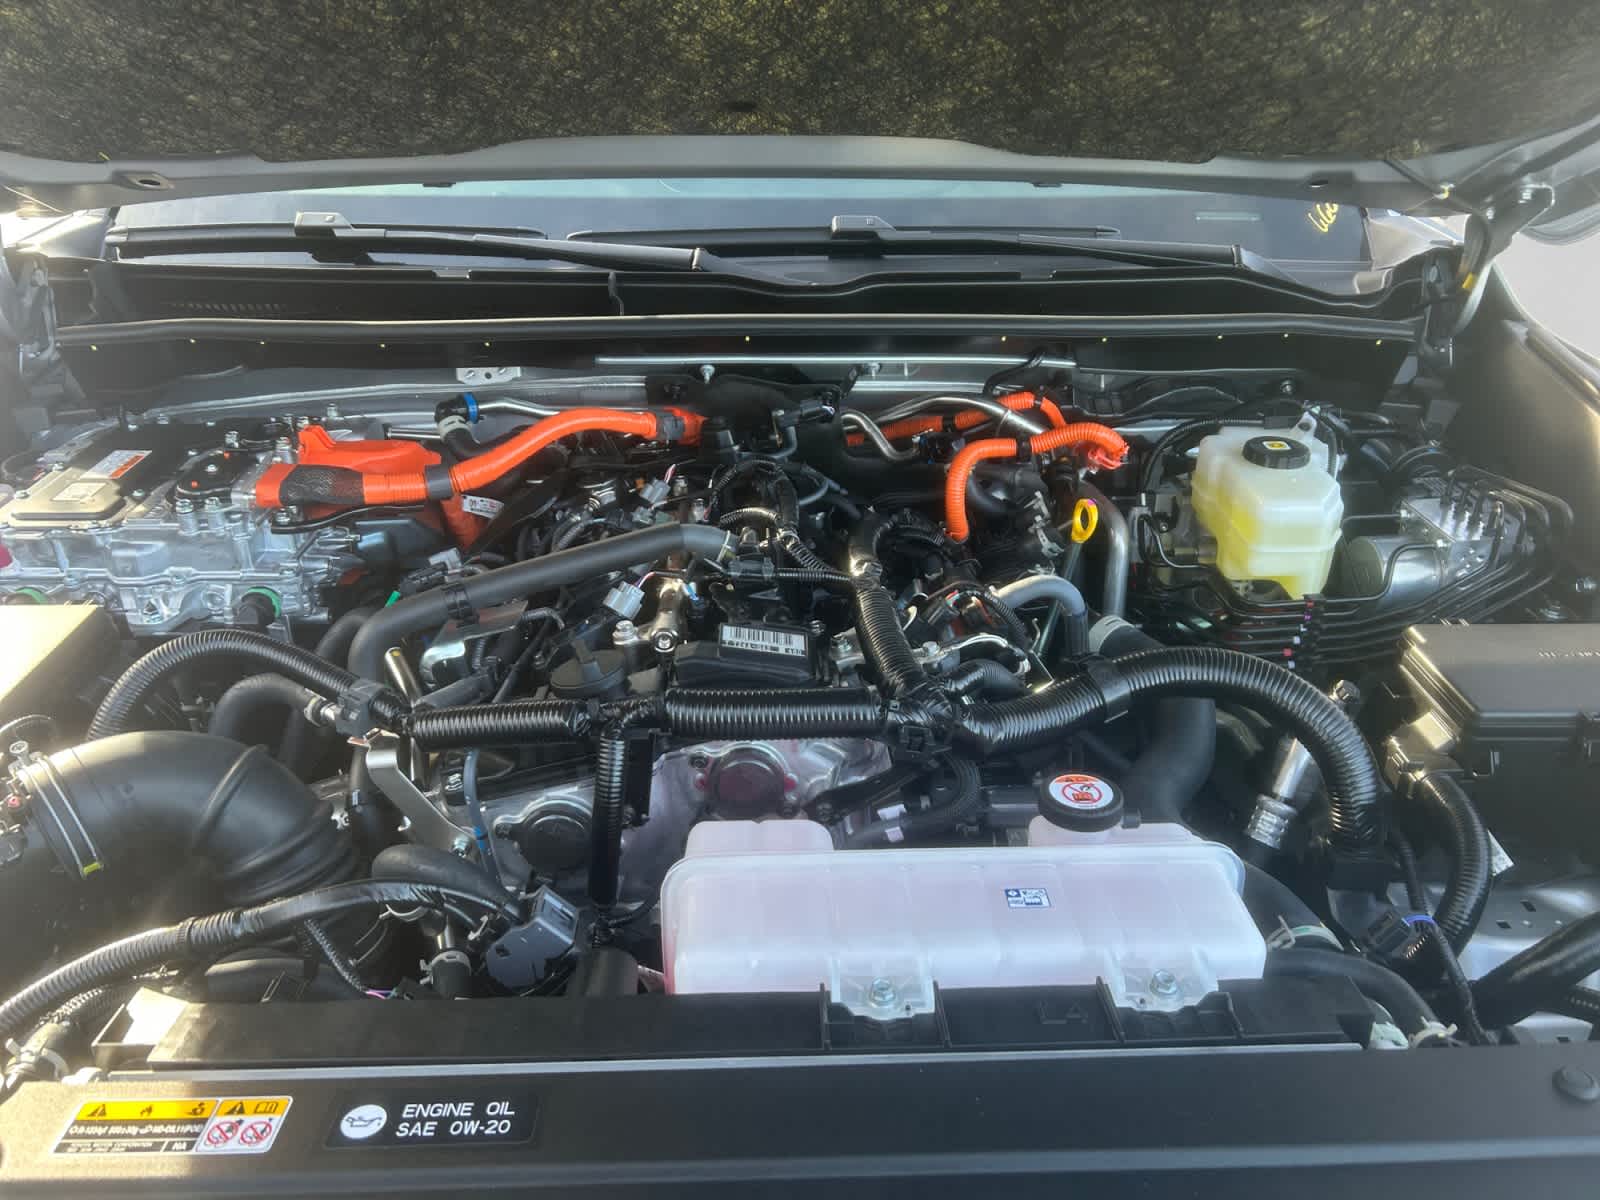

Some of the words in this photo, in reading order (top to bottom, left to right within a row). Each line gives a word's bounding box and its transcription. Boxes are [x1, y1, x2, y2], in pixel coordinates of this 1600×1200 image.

[402, 1102, 474, 1118] ENGINE
[486, 1101, 516, 1116] OIL
[396, 1121, 438, 1137] SAE
[449, 1119, 512, 1136] 0W-20
